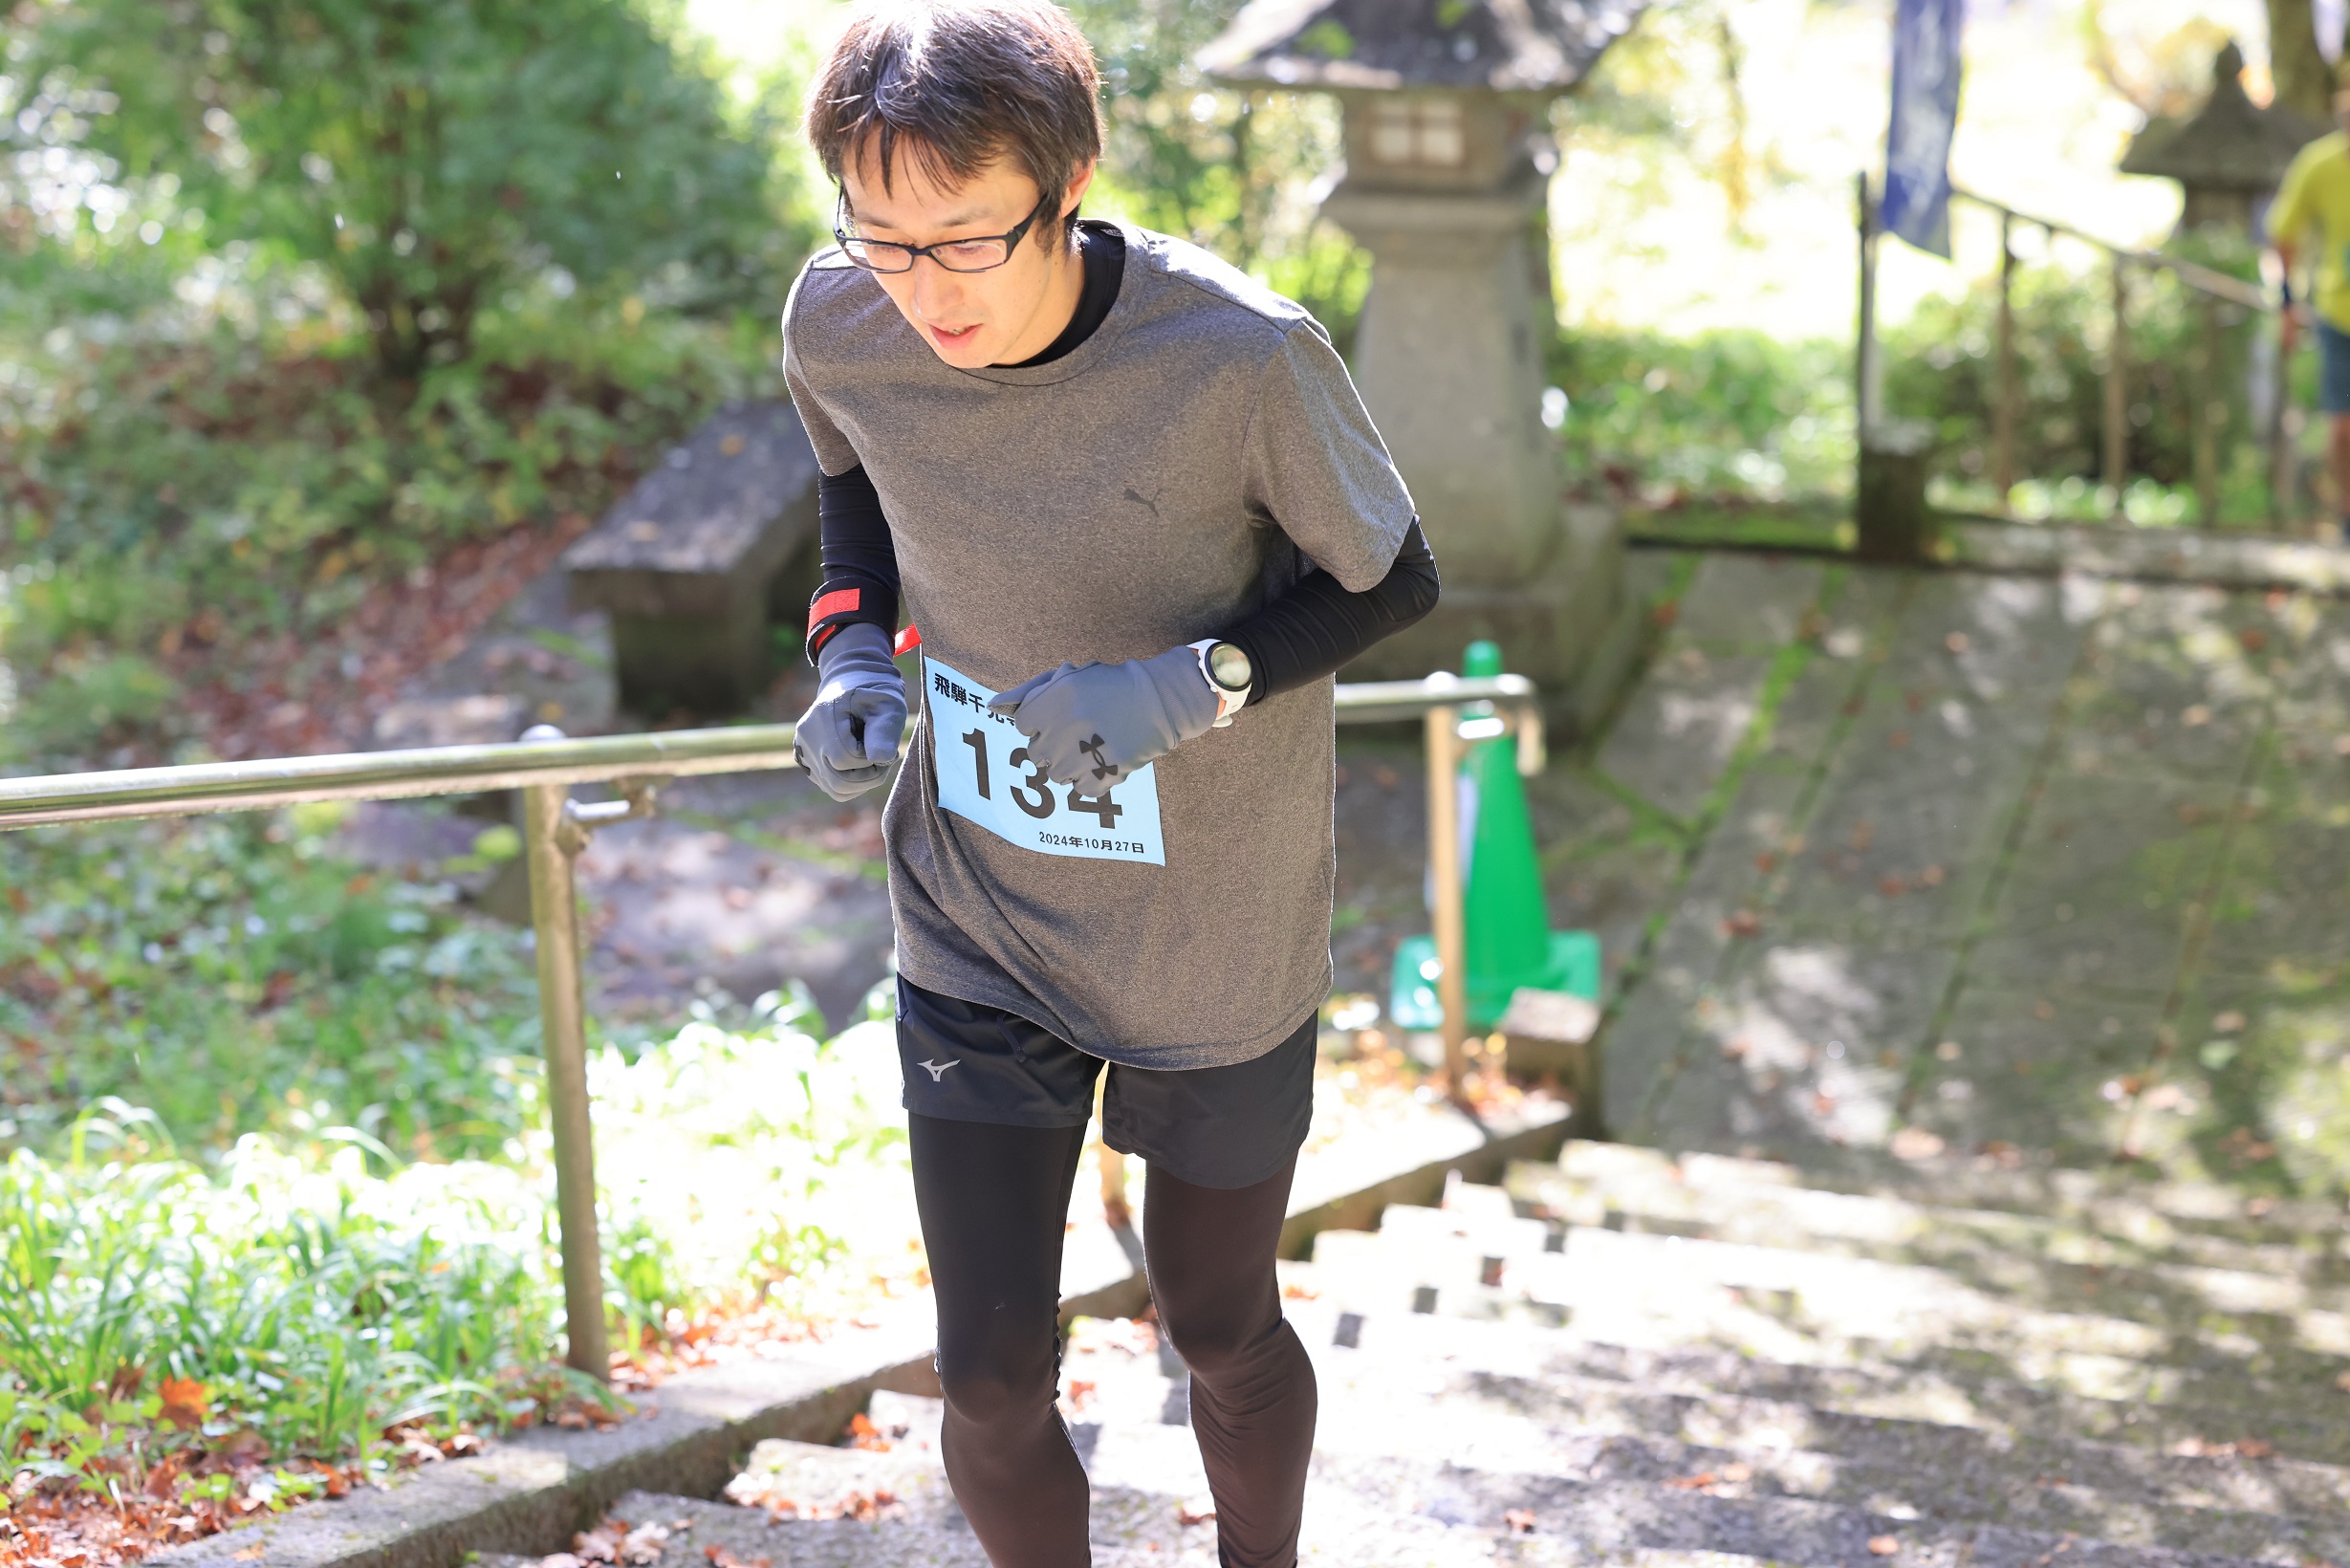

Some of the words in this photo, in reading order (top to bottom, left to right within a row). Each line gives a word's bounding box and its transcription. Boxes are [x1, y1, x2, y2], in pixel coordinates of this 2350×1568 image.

[934, 672, 1015, 727] 飛騨千
[962, 728, 1123, 830] 134
[1038, 831, 1144, 854] 2024年10月27日
